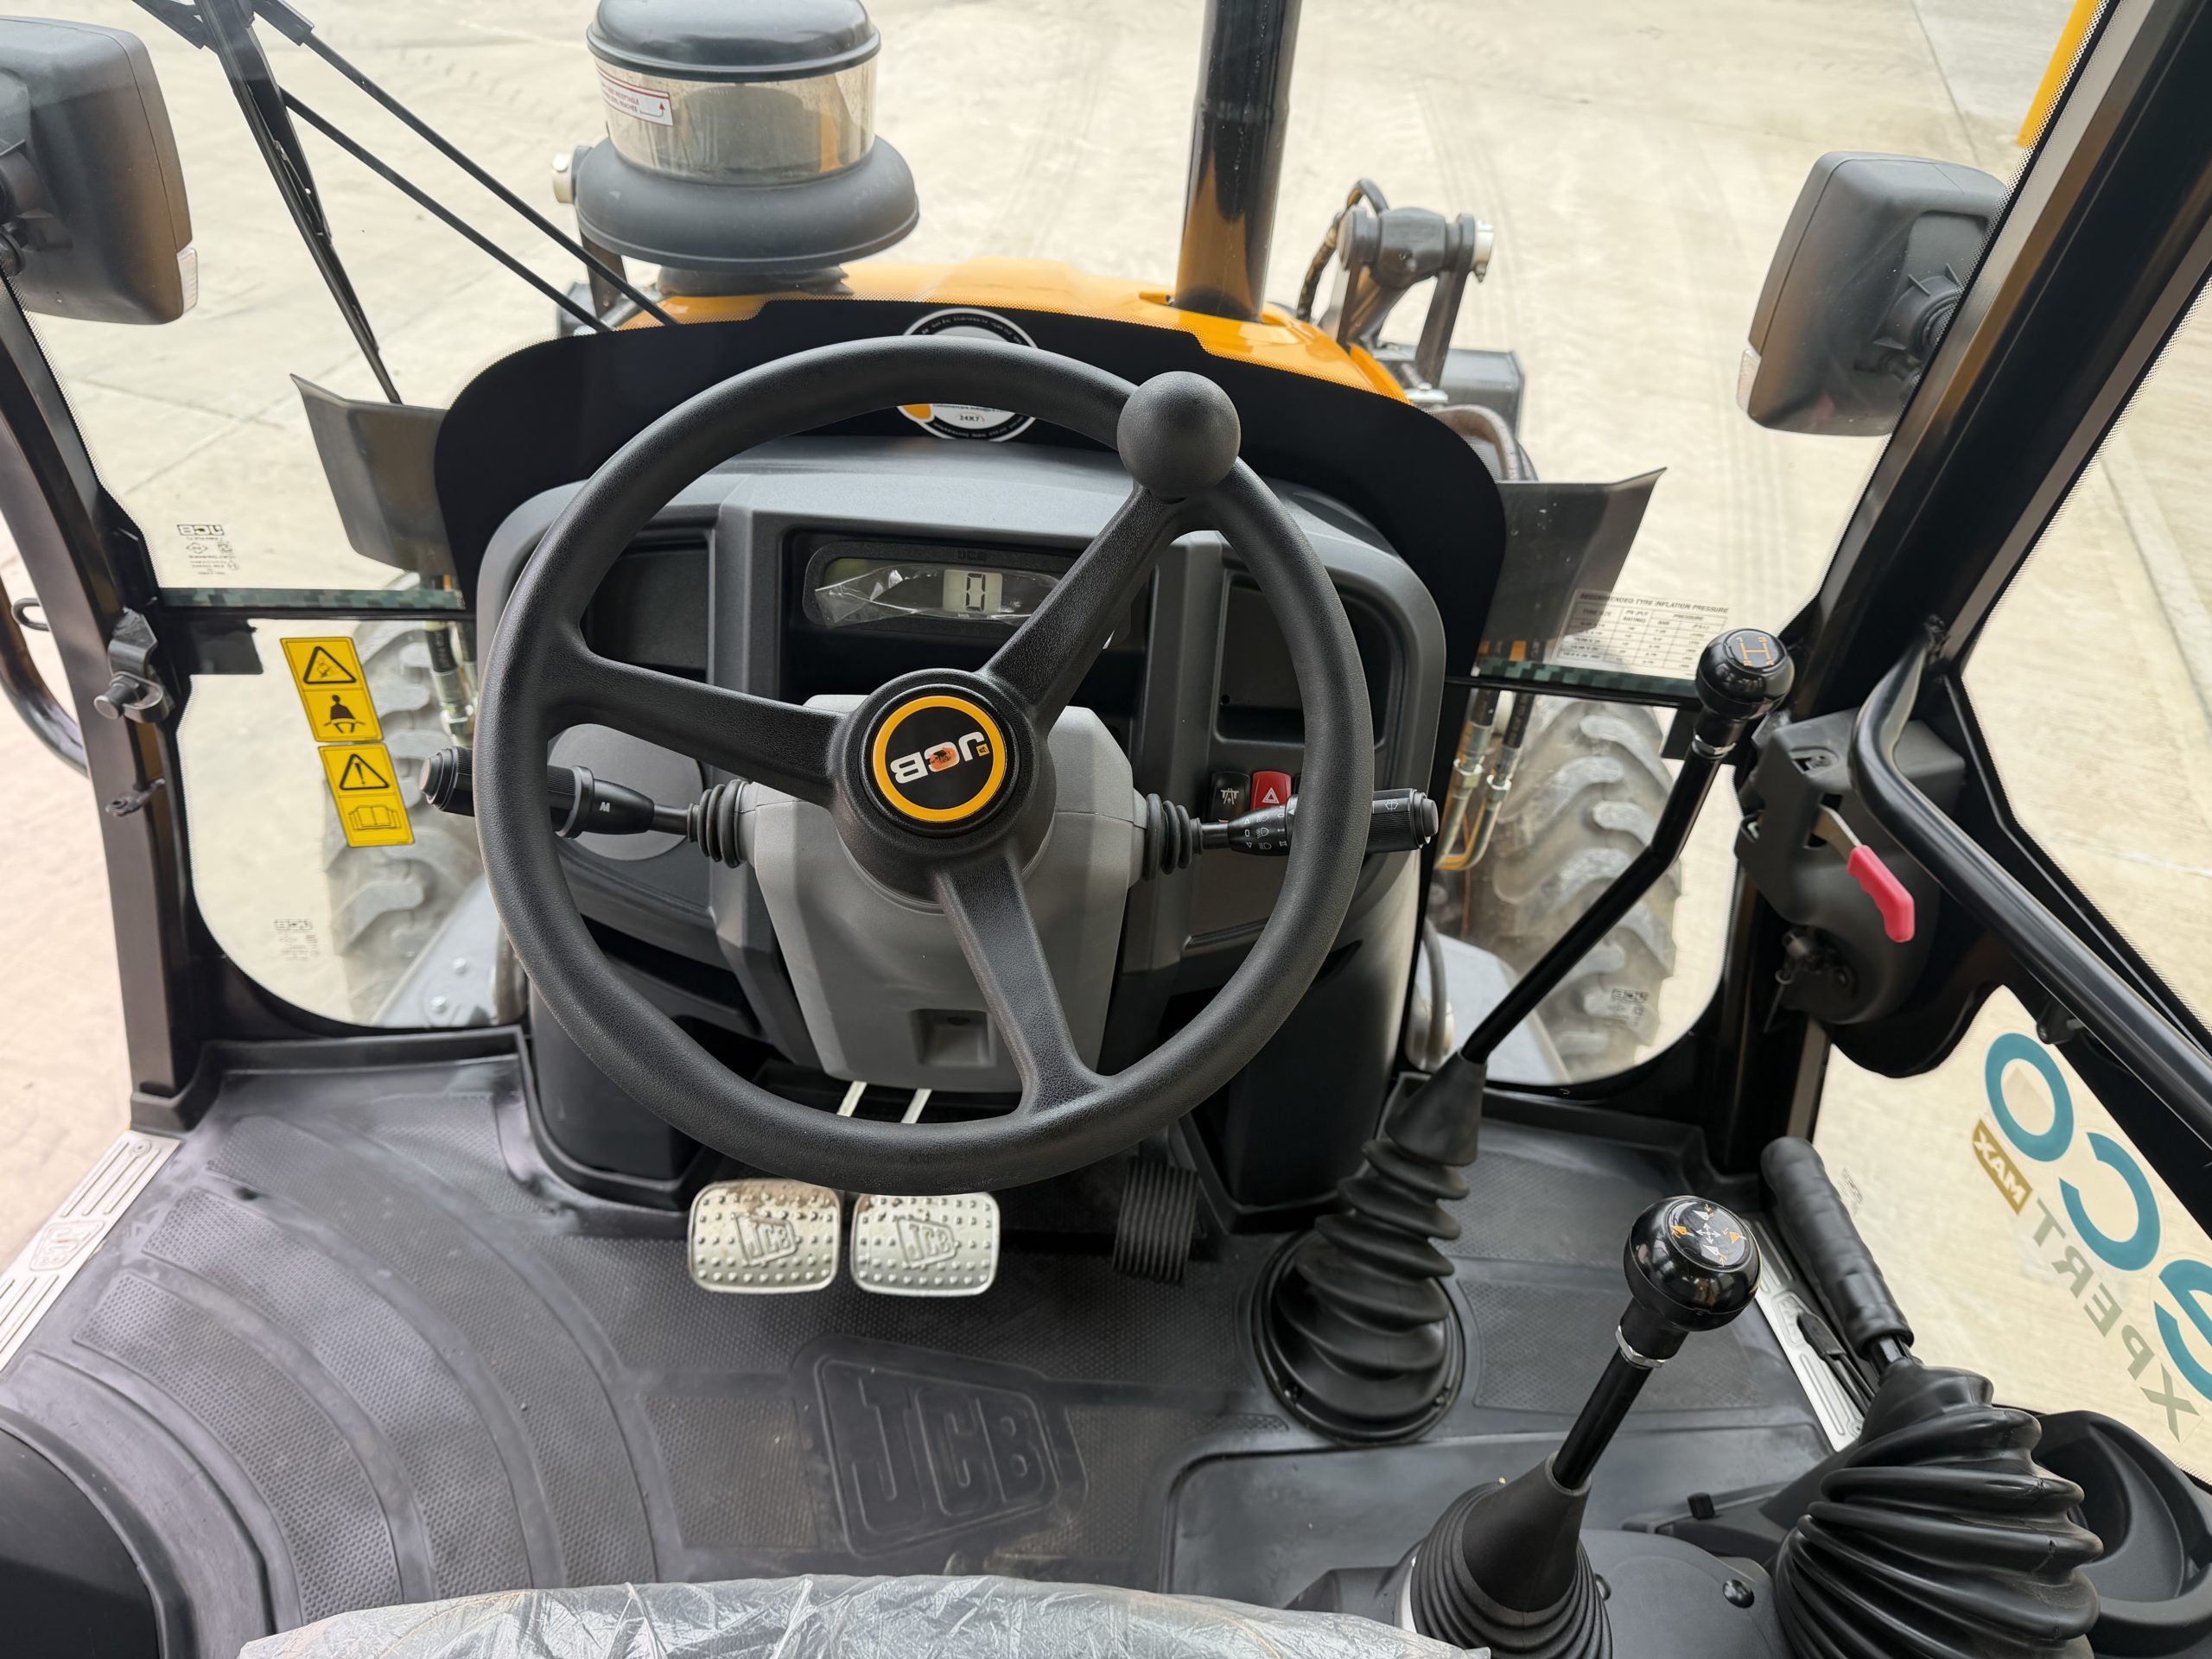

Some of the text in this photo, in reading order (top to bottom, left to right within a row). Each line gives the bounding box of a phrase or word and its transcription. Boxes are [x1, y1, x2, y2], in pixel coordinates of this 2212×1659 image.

[965, 573, 986, 612] 0
[1580, 593, 1729, 613] RECOMMENDED TYRE INFLATION PRESSURE
[890, 732, 985, 784] JCB
[851, 1377, 1046, 1535] JCB
